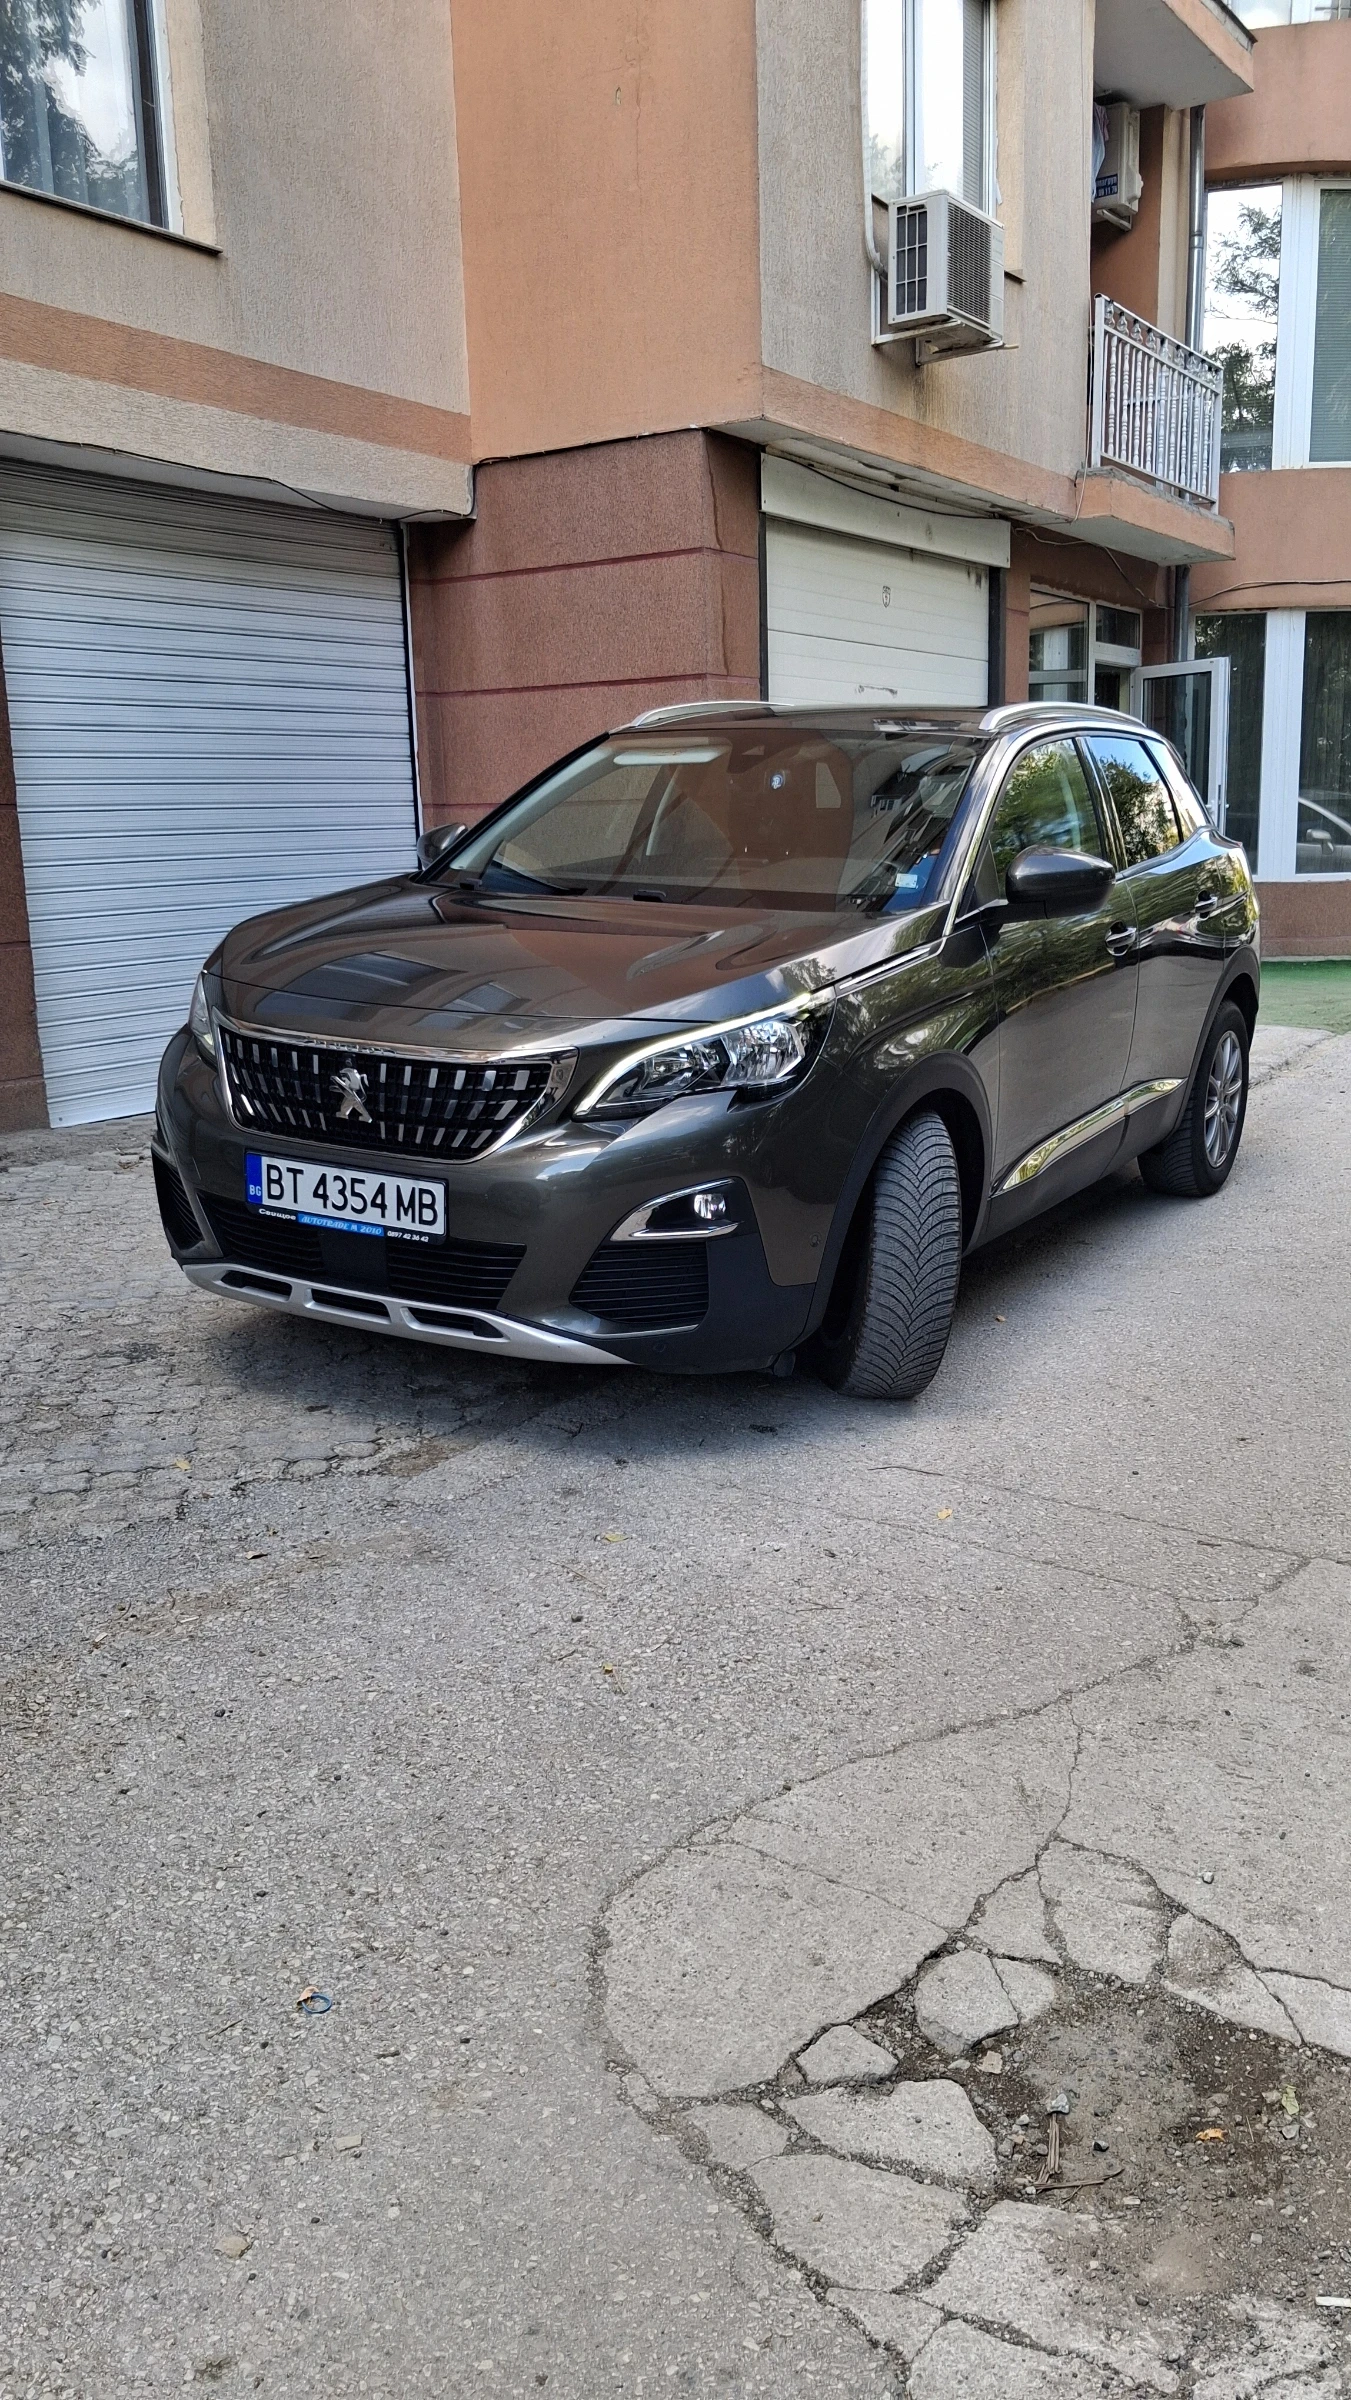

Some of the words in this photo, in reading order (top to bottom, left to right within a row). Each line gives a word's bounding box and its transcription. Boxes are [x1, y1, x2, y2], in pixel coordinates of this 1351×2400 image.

[249, 1184, 262, 1197] BG
[266, 1163, 304, 1204] BT
[312, 1172, 388, 1219] 4354
[396, 1184, 438, 1226] MB
[301, 1215, 350, 1230] AUTOTRADE
[350, 1224, 358, 1232] M
[360, 1225, 382, 1235] 2010
